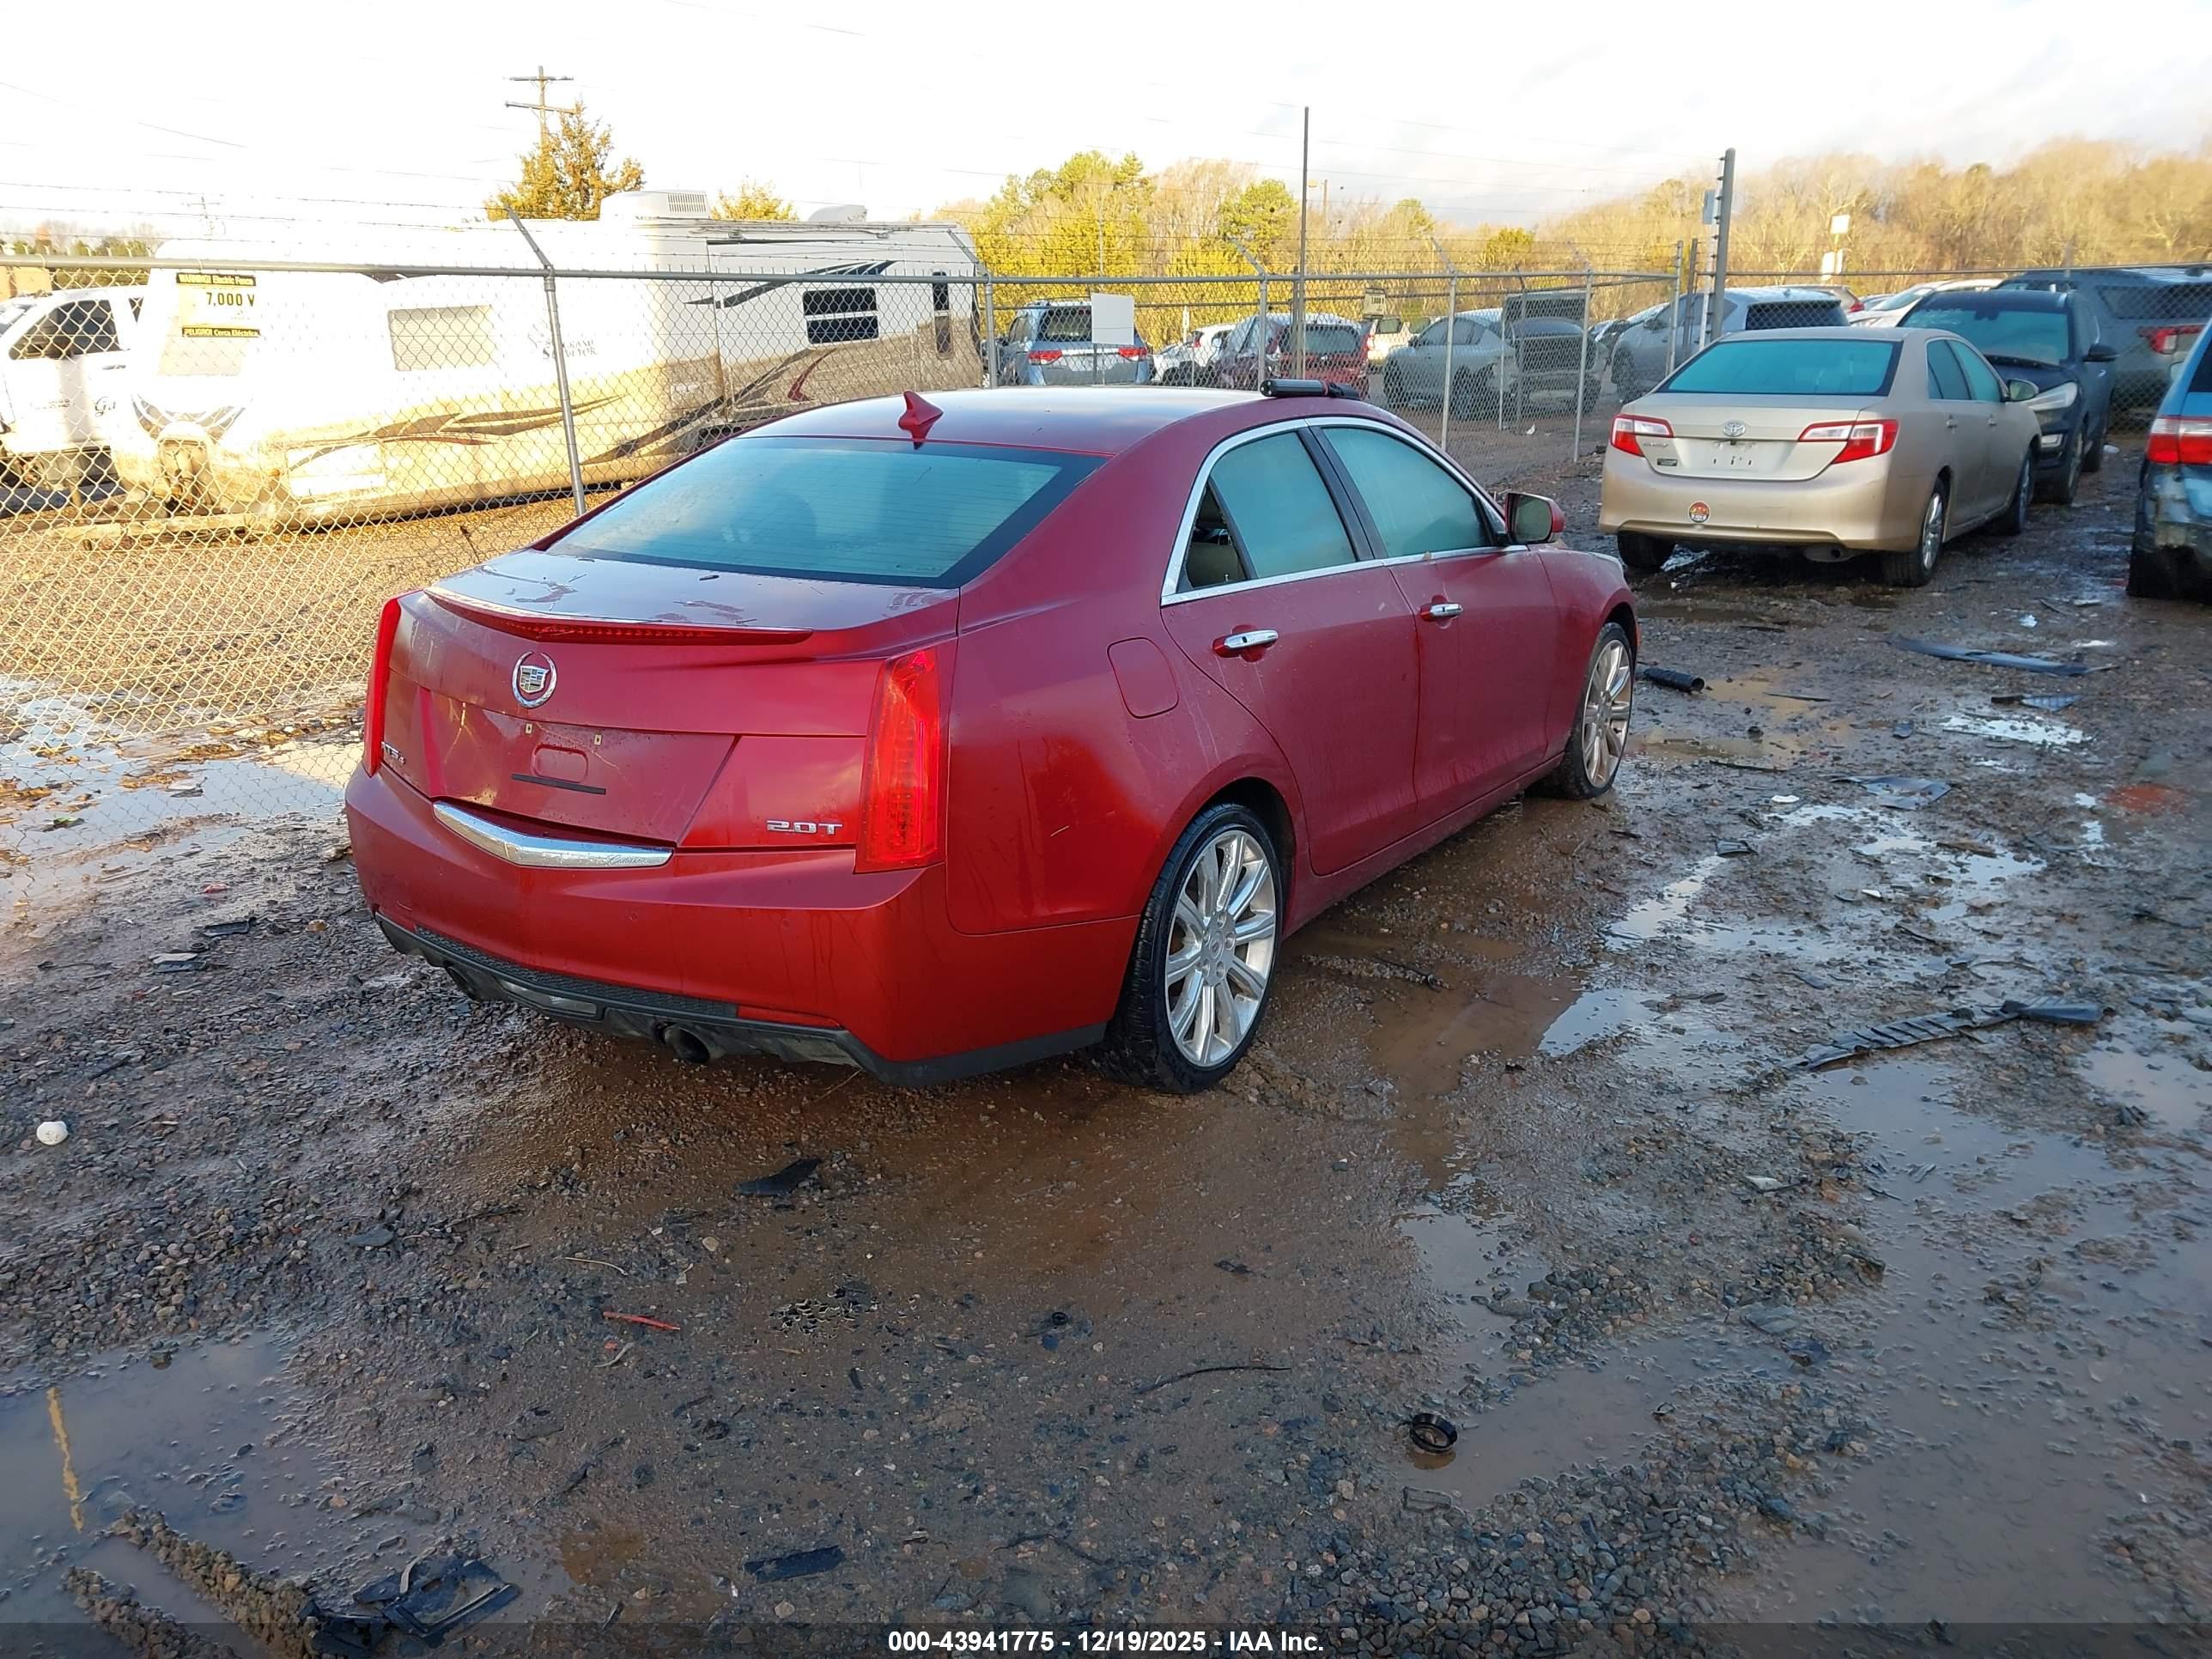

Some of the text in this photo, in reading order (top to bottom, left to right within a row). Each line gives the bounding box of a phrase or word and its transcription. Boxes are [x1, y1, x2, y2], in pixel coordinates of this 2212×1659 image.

[212, 275, 234, 285] Electric
[234, 276, 255, 286] Fence
[206, 291, 255, 307] 7,000 V
[214, 328, 232, 337] Cerca
[766, 820, 843, 836] 2.0T
